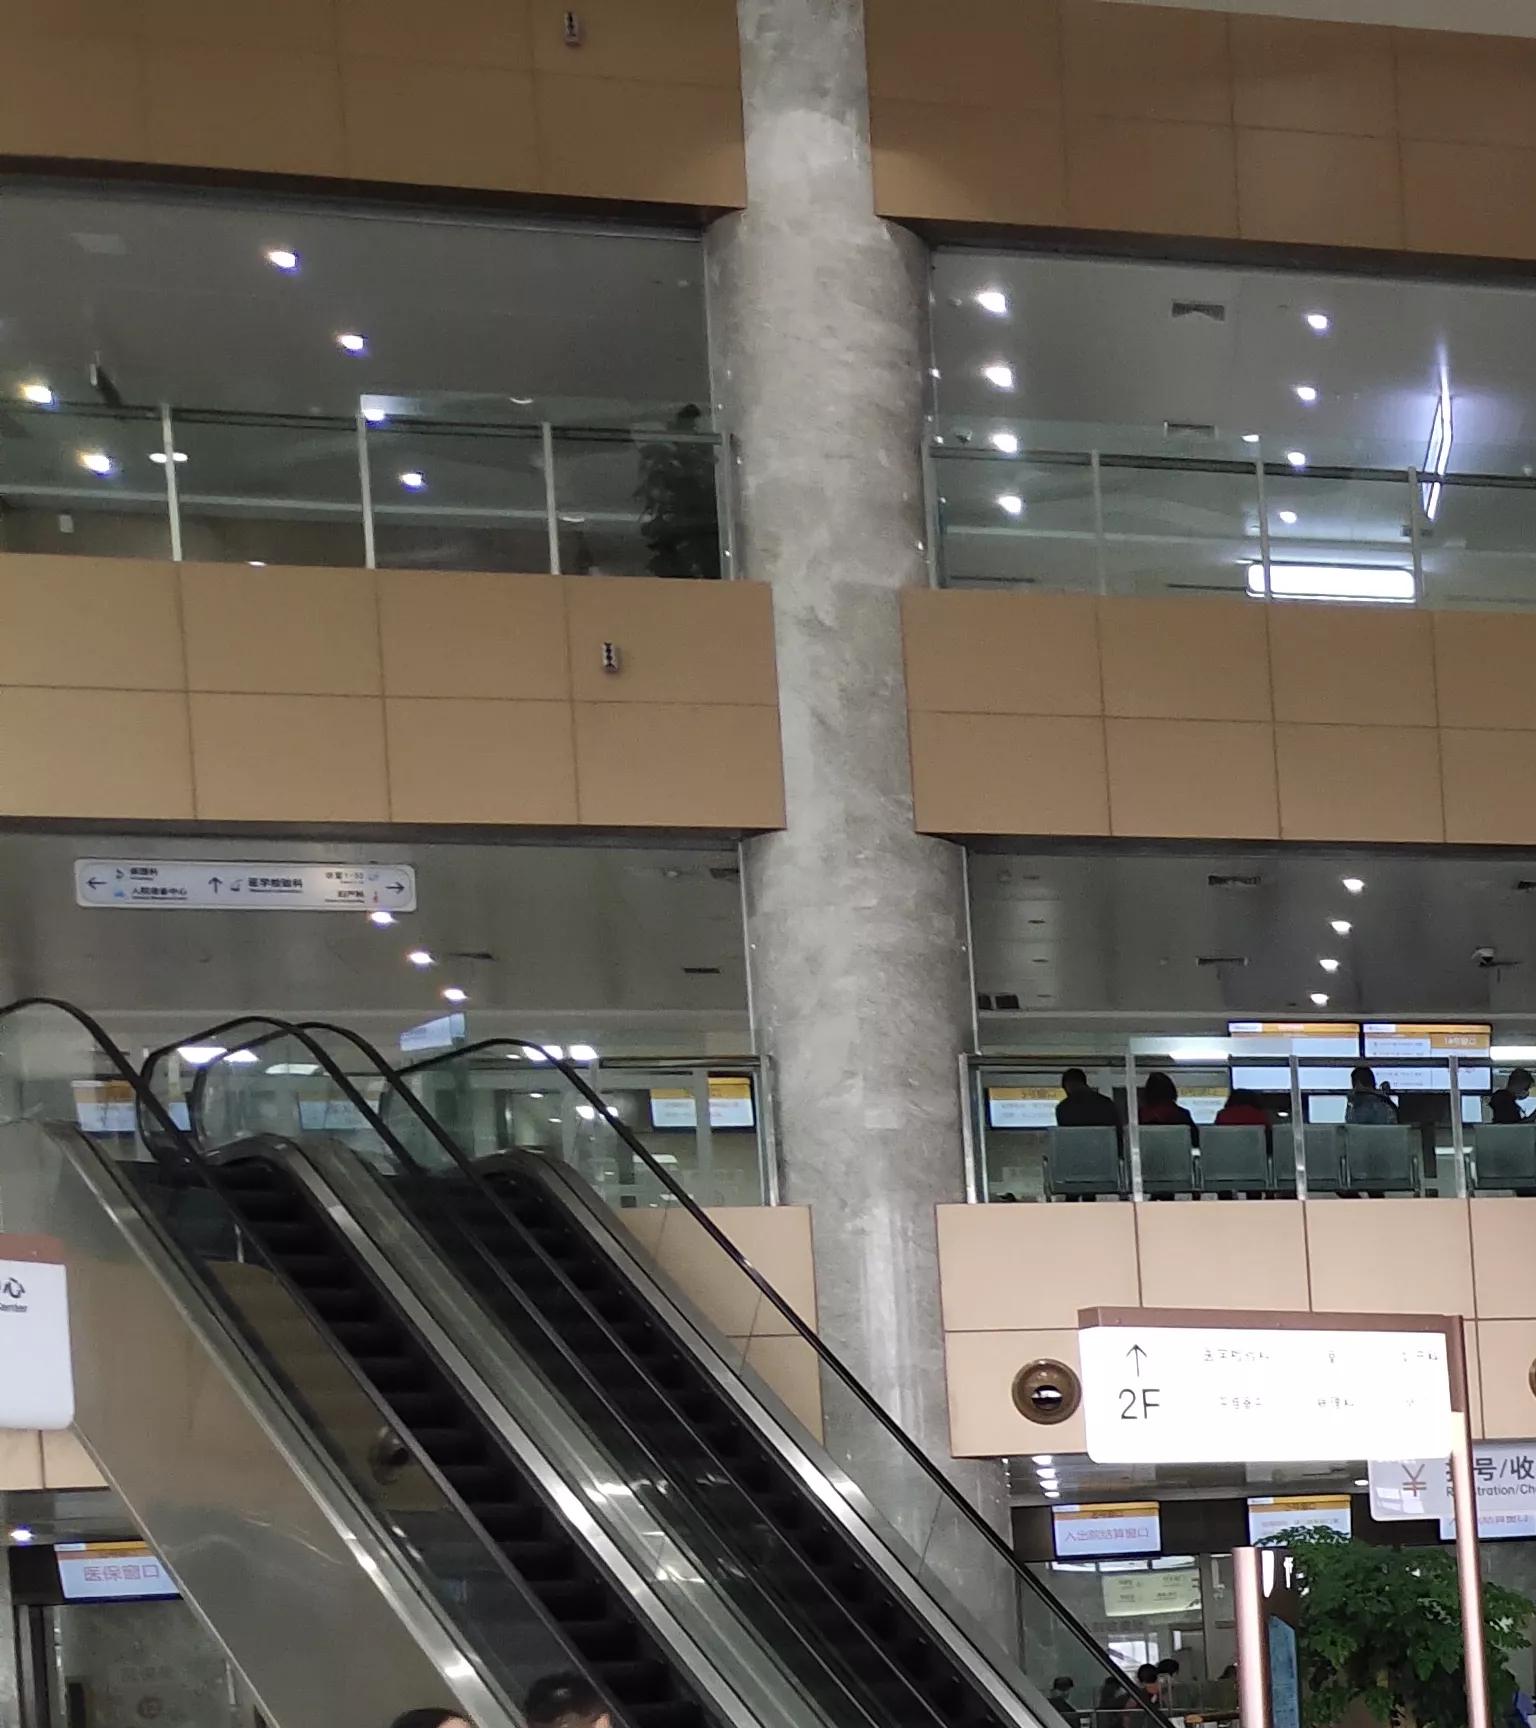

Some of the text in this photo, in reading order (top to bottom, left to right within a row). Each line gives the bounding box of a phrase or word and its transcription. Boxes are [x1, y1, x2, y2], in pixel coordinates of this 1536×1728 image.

[0, 1276, 26, 1299] 心
[1118, 1387, 1161, 1420] 2F
[83, 1564, 159, 1582] 医保窗口
